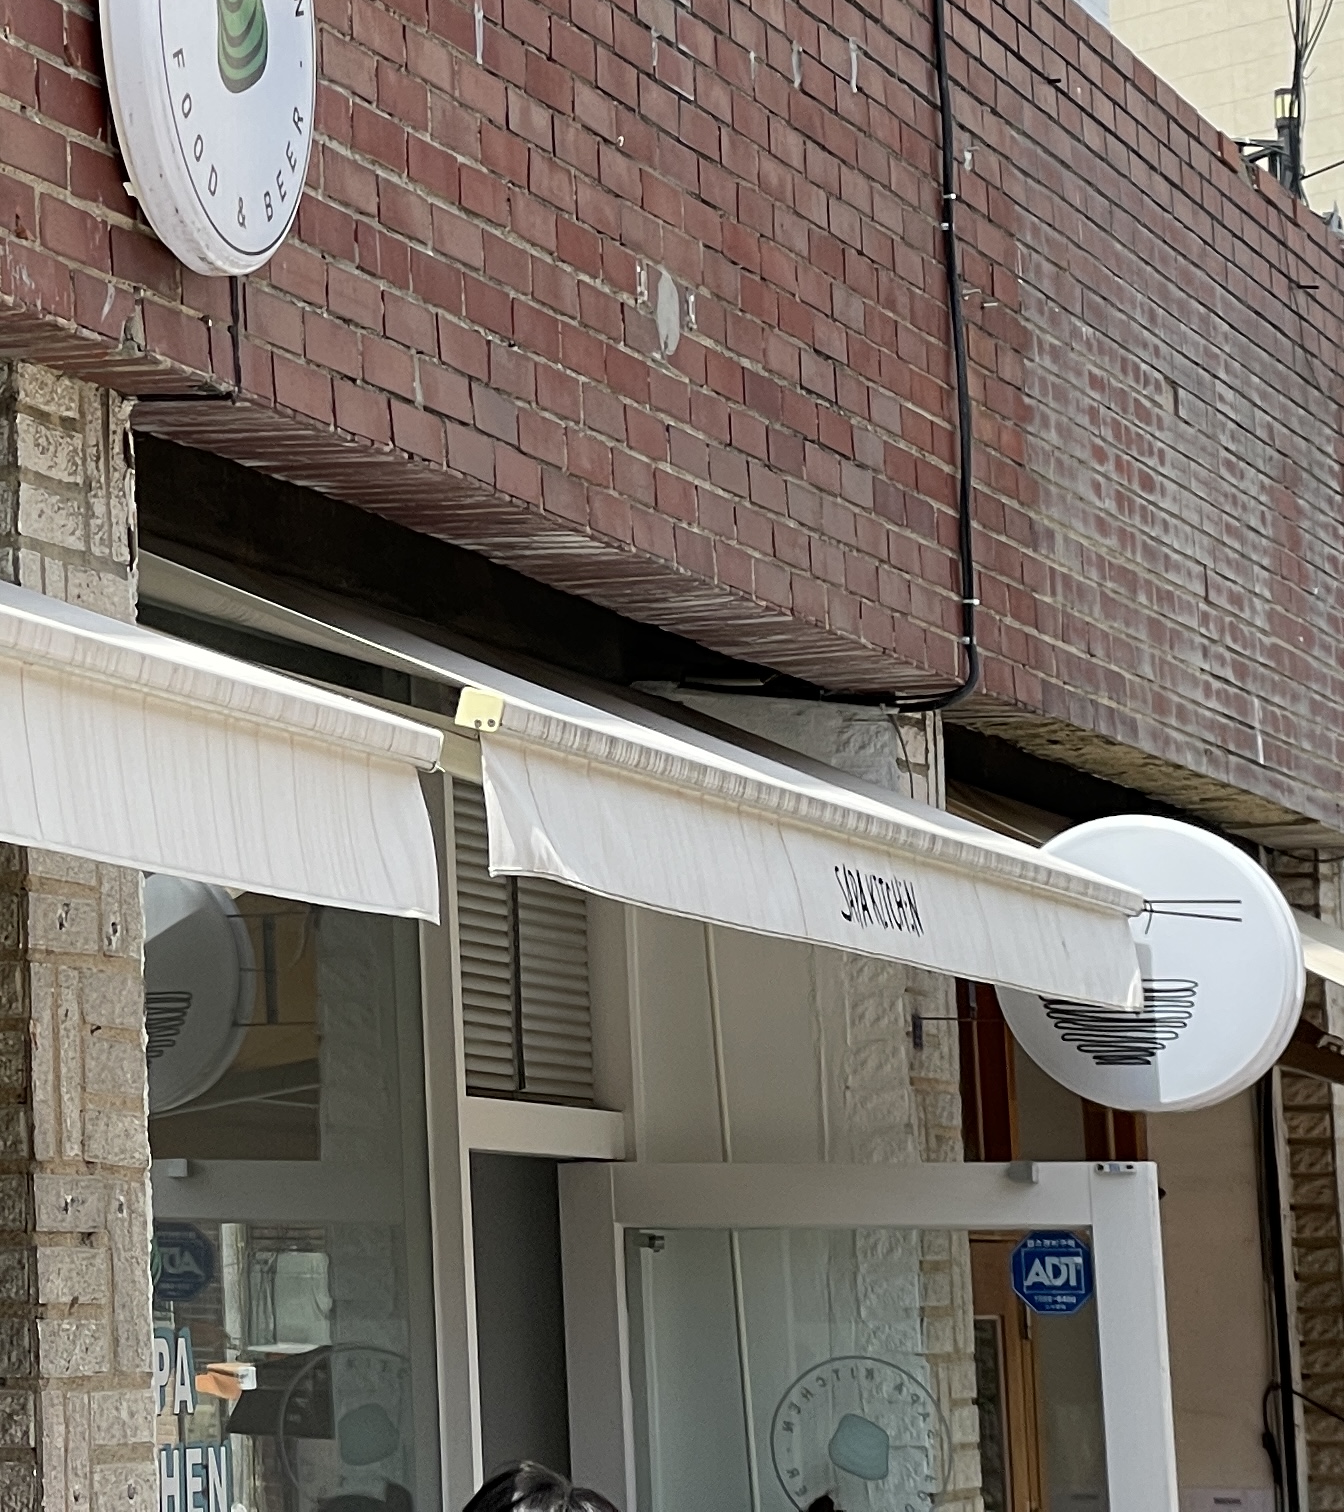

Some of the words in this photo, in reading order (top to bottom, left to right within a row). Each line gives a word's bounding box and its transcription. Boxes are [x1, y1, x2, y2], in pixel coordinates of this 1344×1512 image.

[172, 47, 219, 197] FOOD
[236, 196, 247, 229] &
[264, 105, 305, 223] BEER
[834, 864, 874, 930] SAPA
[865, 873, 925, 938] KITCHEN
[1023, 1256, 1083, 1286] ADT
[153, 1337, 196, 1416] PA
